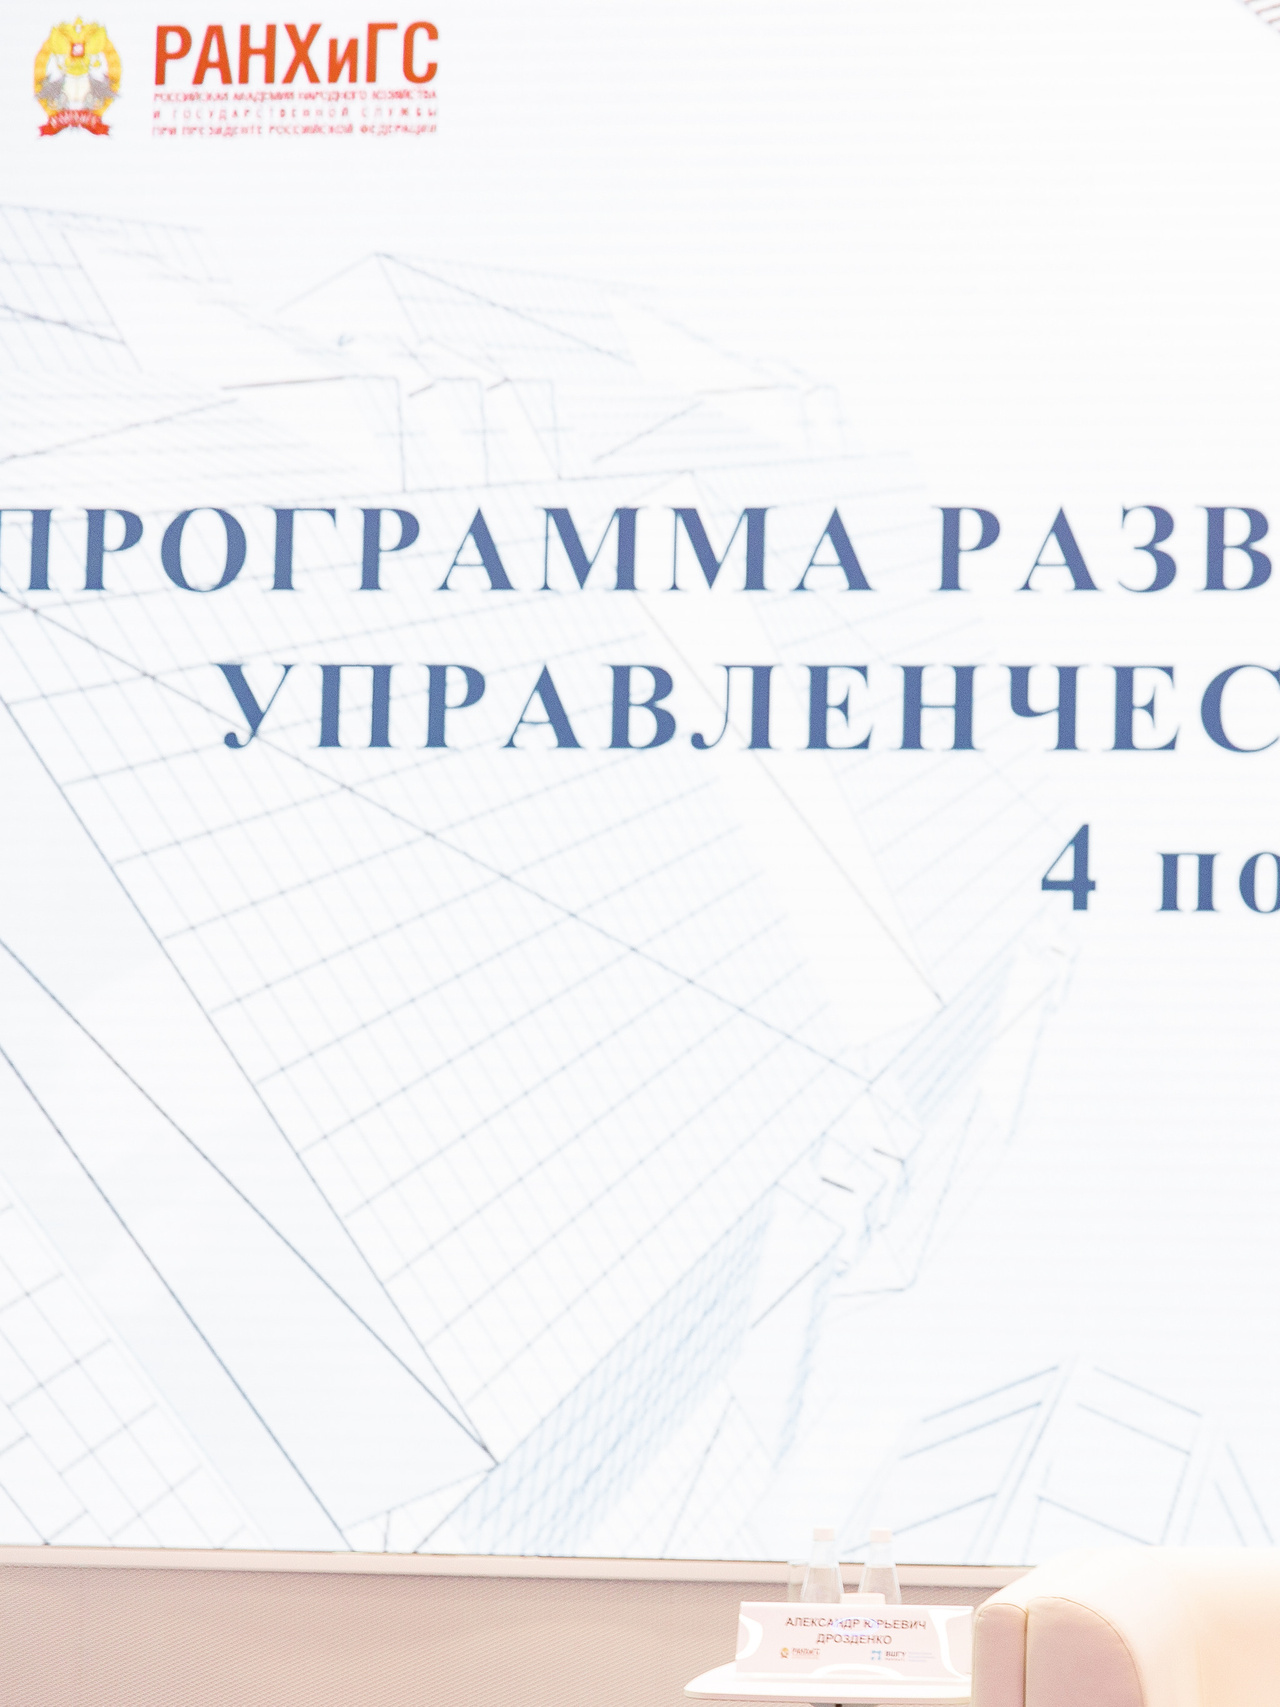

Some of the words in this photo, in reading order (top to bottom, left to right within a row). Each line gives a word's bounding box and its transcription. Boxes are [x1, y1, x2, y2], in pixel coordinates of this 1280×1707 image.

[154, 20, 439, 86] РАНХиГС
[0, 506, 875, 593] ПРОГРАММА
[1041, 824, 1096, 910] 4
[816, 1633, 893, 1646] ДРОЗДЕНКО
